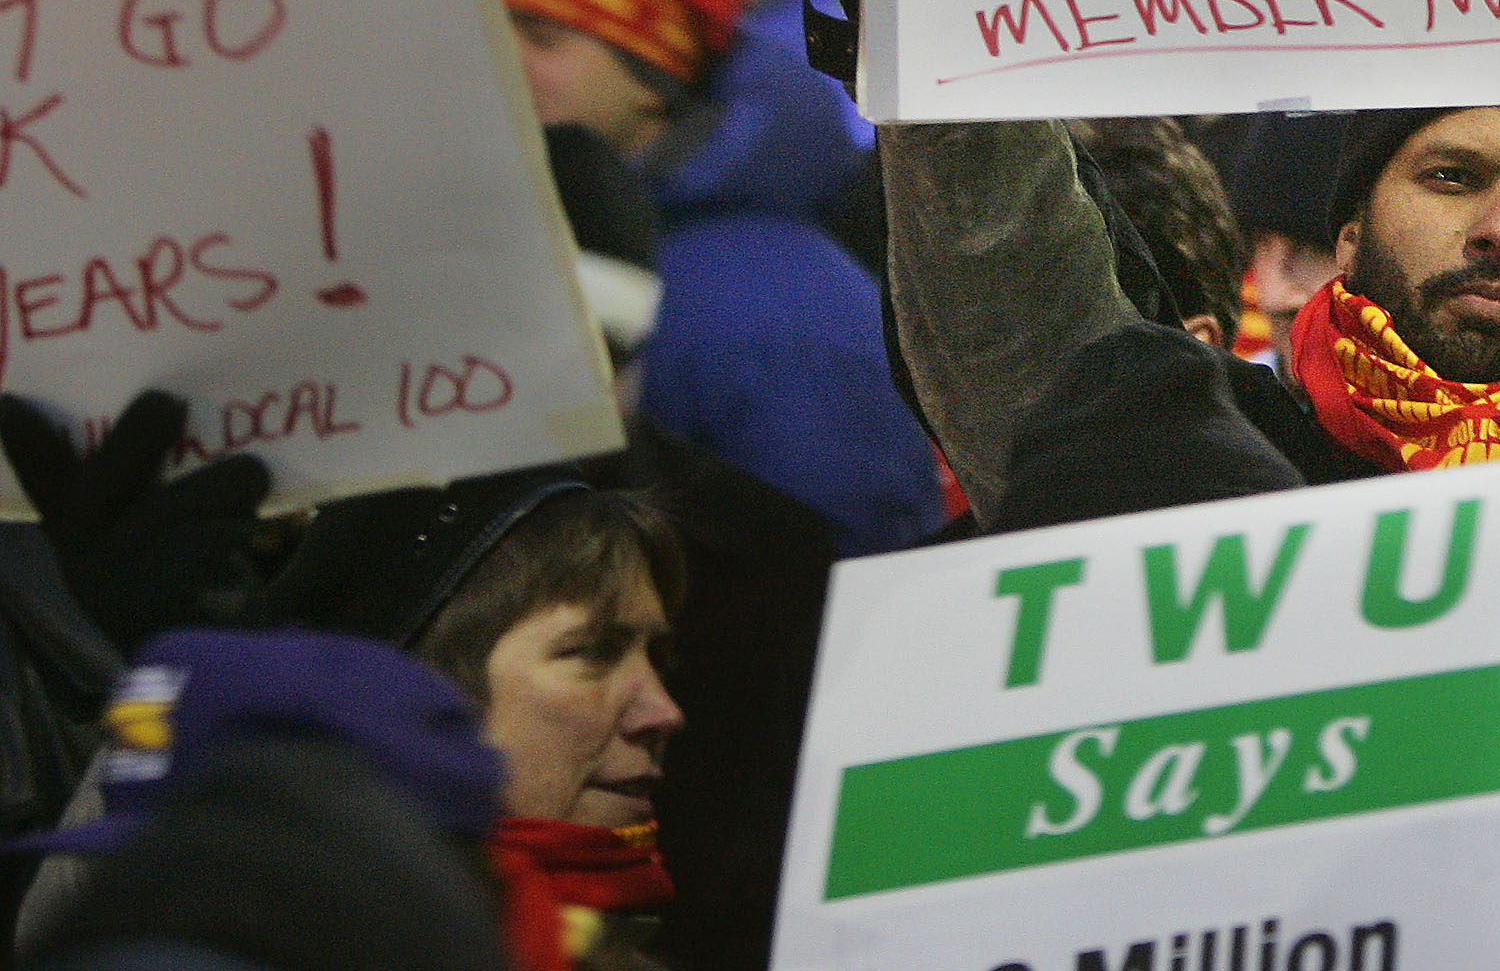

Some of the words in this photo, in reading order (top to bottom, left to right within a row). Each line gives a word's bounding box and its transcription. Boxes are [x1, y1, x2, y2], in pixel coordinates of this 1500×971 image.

[398, 356, 514, 429] 100
[992, 499, 1484, 691] TWU
[1024, 713, 1372, 835] Says
